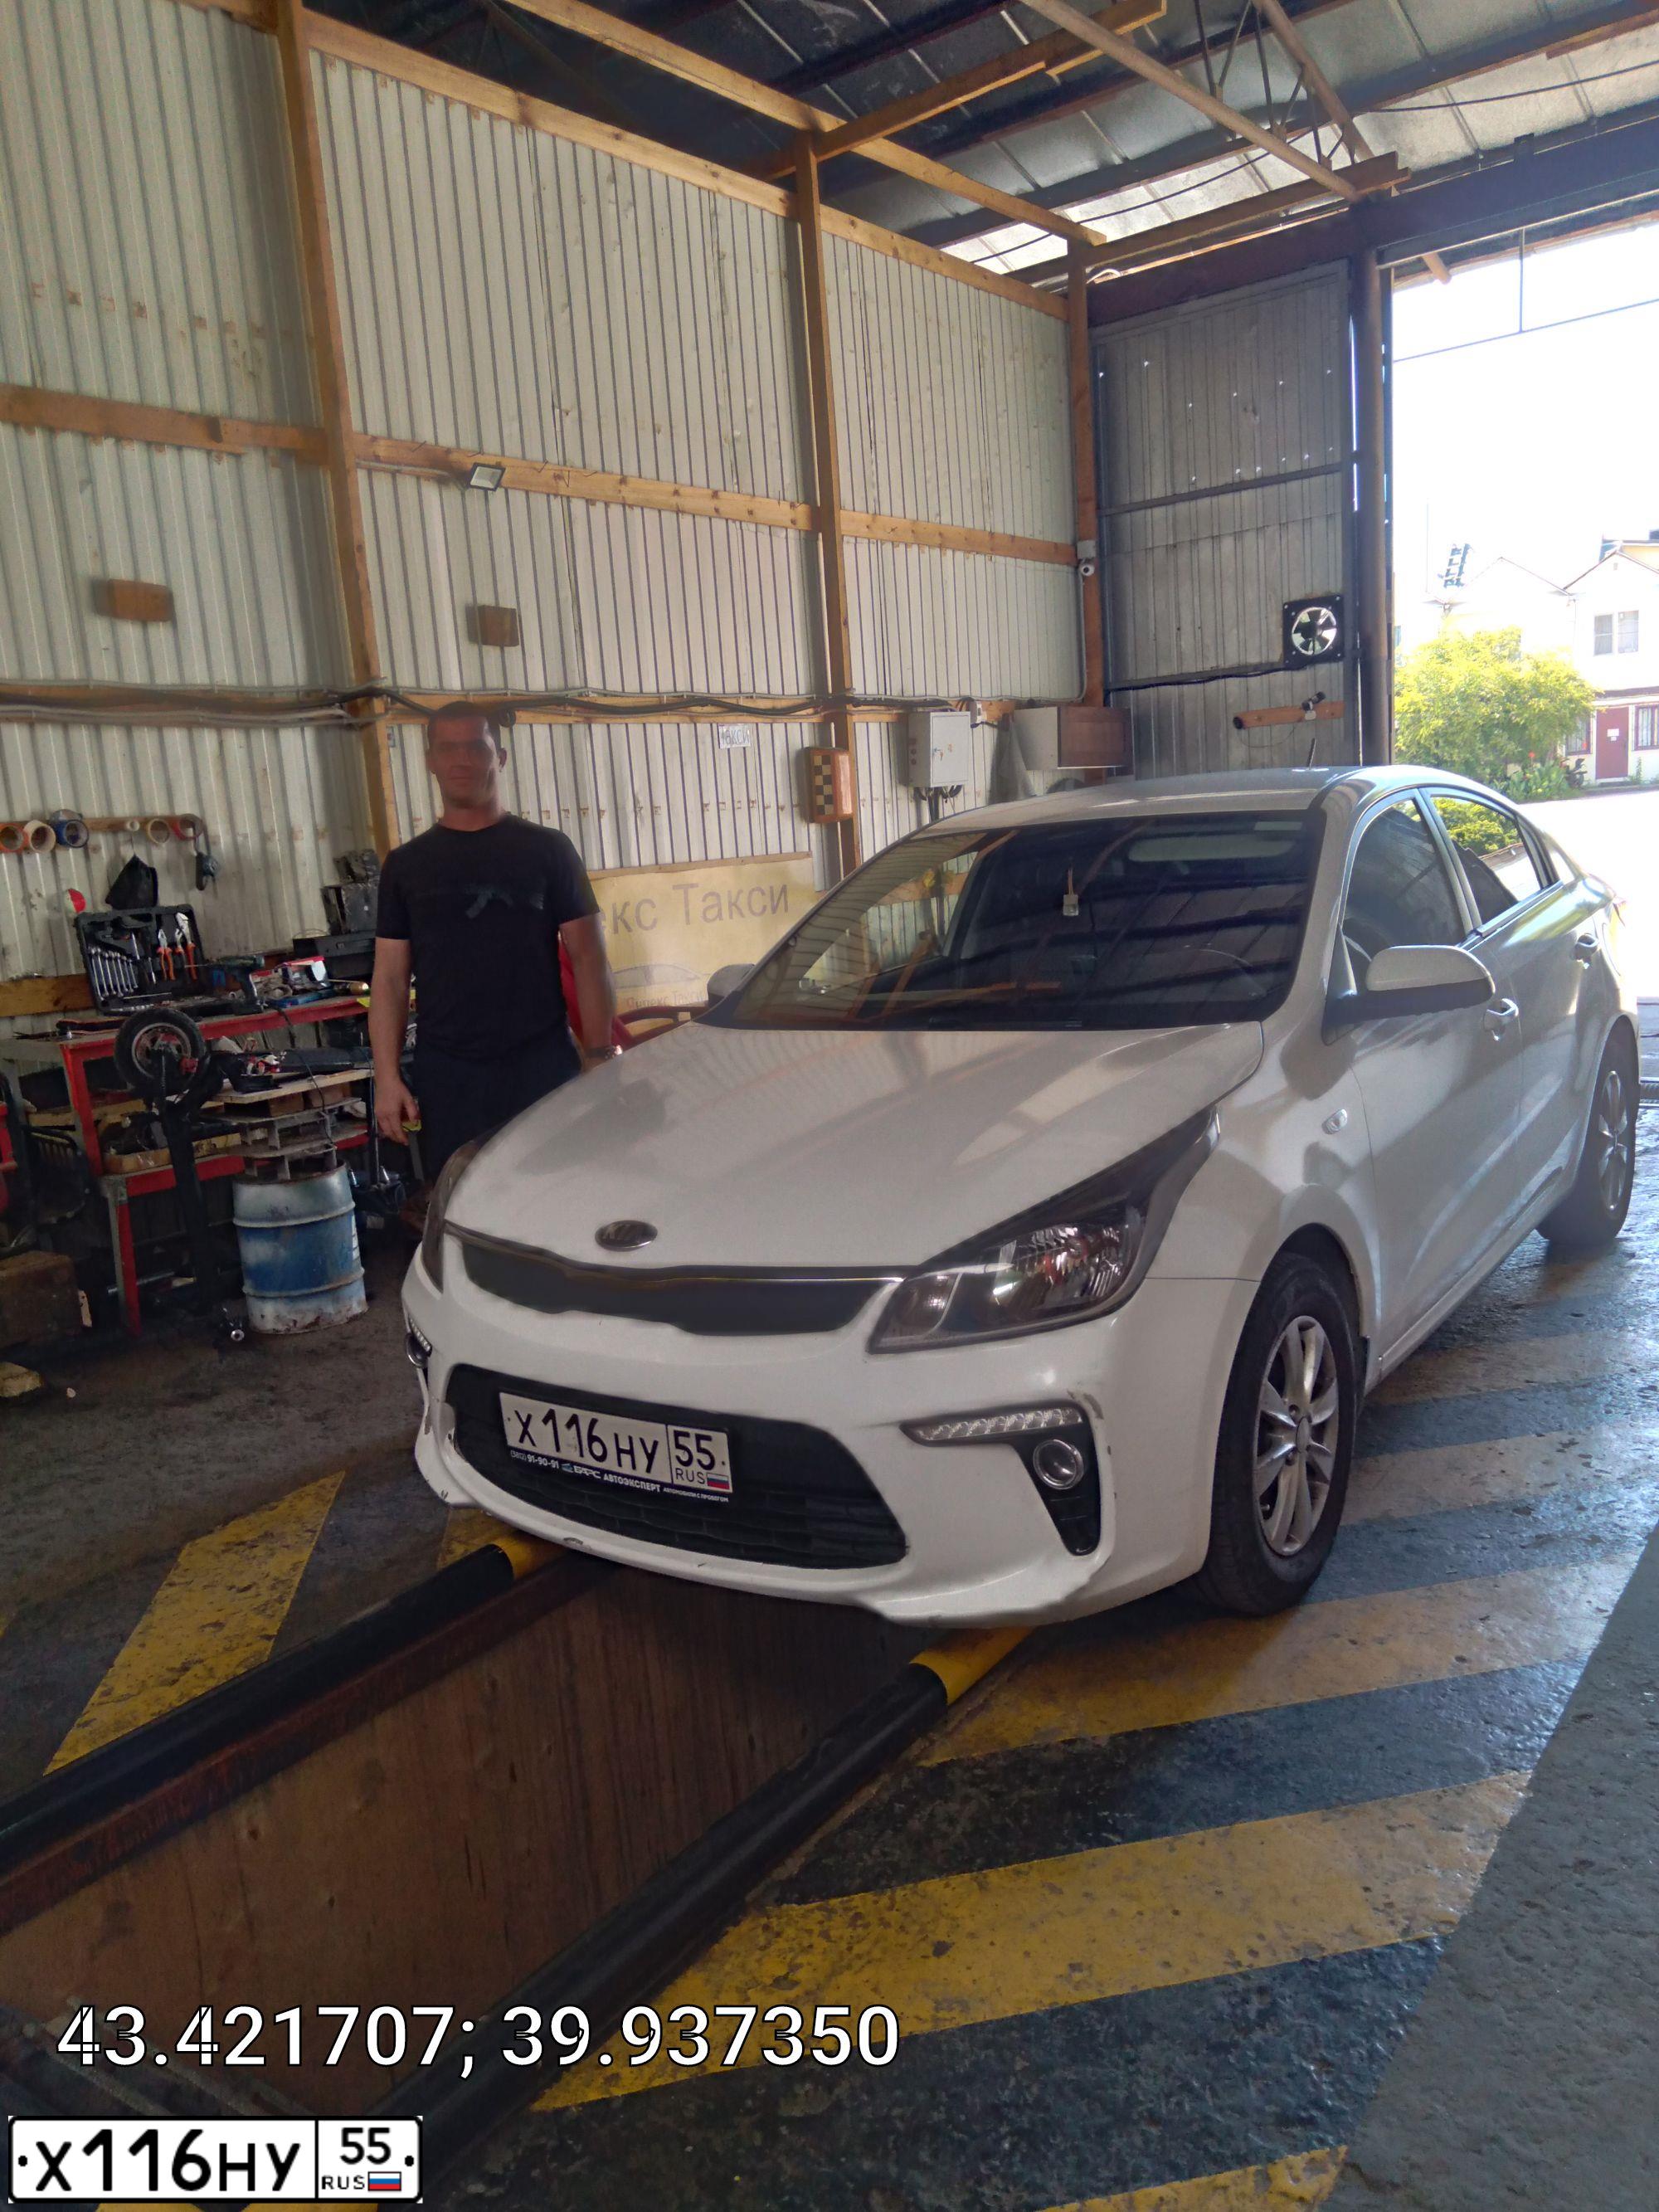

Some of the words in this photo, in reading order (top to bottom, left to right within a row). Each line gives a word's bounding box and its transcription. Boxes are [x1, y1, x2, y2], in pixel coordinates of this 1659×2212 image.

[673, 883, 788, 925] Такси
[514, 1408, 659, 1474] Х116НУ
[673, 1430, 716, 1470] 55
[603, 1473, 661, 1493] АВТОЭКСПЕРТ
[676, 1468, 705, 1484] RUS
